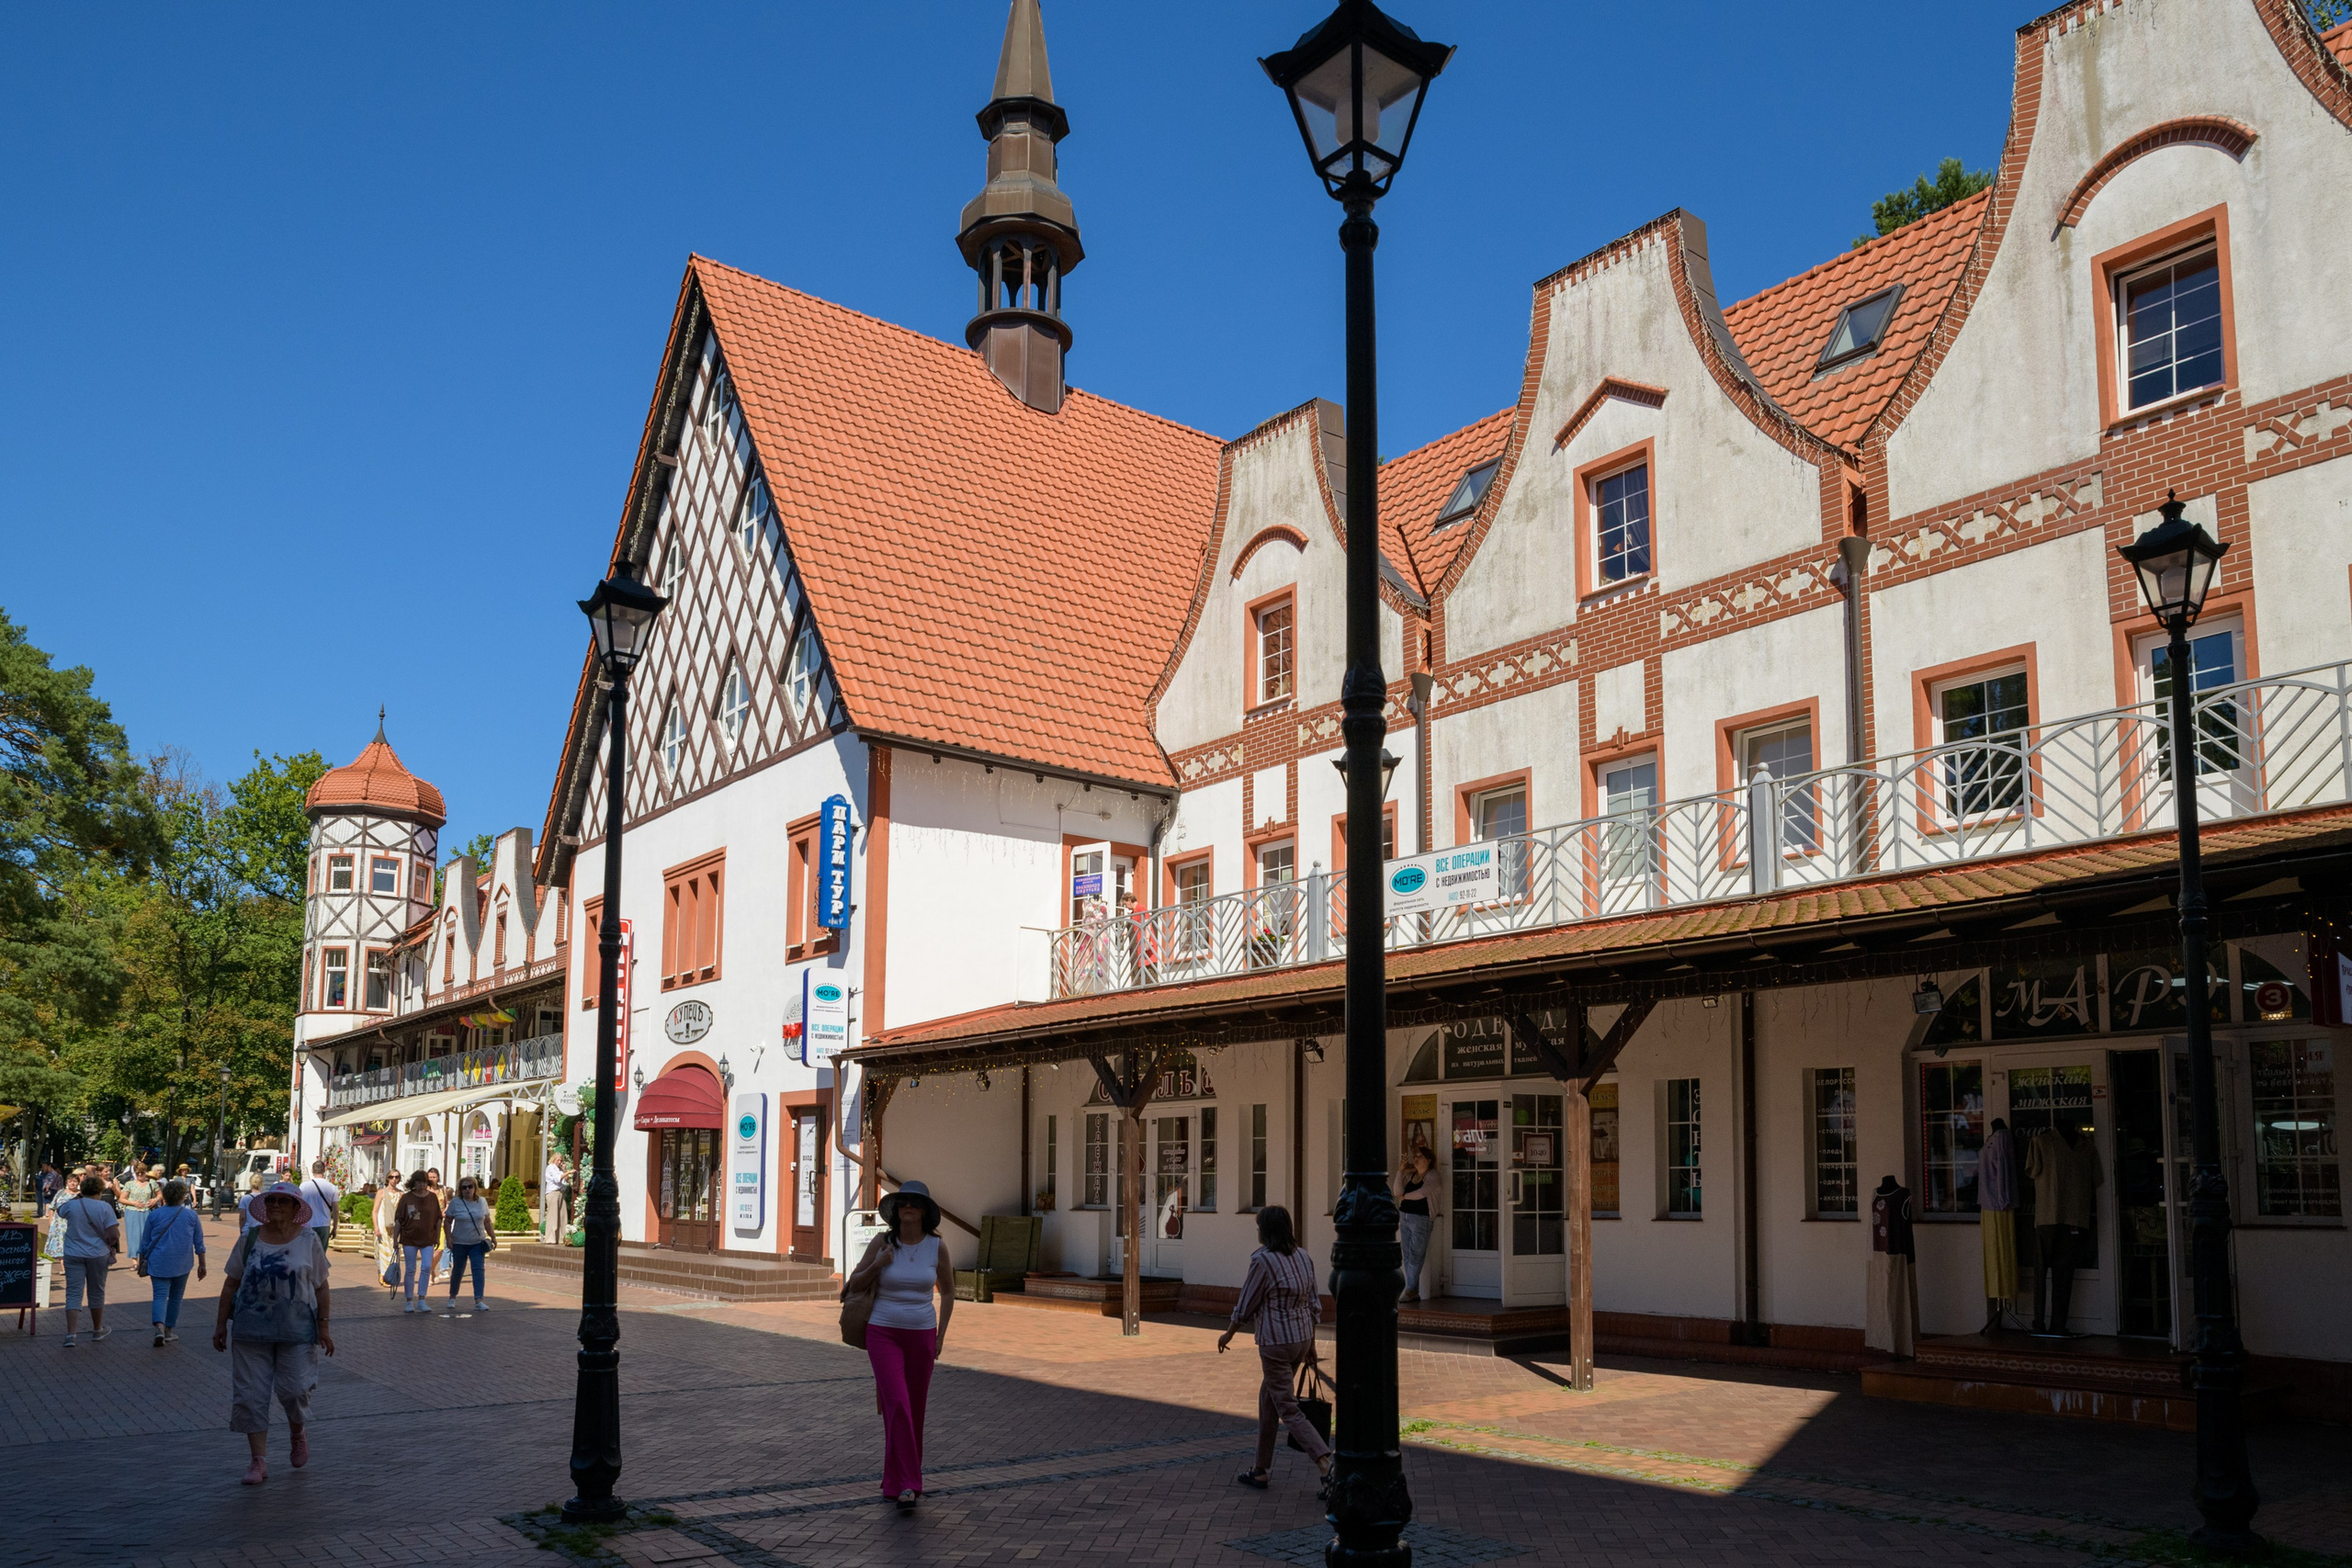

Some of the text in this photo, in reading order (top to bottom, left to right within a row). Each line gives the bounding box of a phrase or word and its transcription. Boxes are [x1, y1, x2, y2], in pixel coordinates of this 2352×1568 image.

[831, 805, 847, 865] ПАРИ
[1435, 849, 1490, 874] ВСЕ ОПЕРАЦИИ
[1442, 868, 1490, 887] НЕДВИЖИМОСТЬЮ
[830, 870, 844, 914] ТУР
[673, 1004, 704, 1025] КУПЕЦЪ
[1453, 1011, 1567, 1039] ОДЕД
[1457, 1044, 1503, 1054] женская
[1093, 1116, 1102, 1203] ОДЕЖДА
